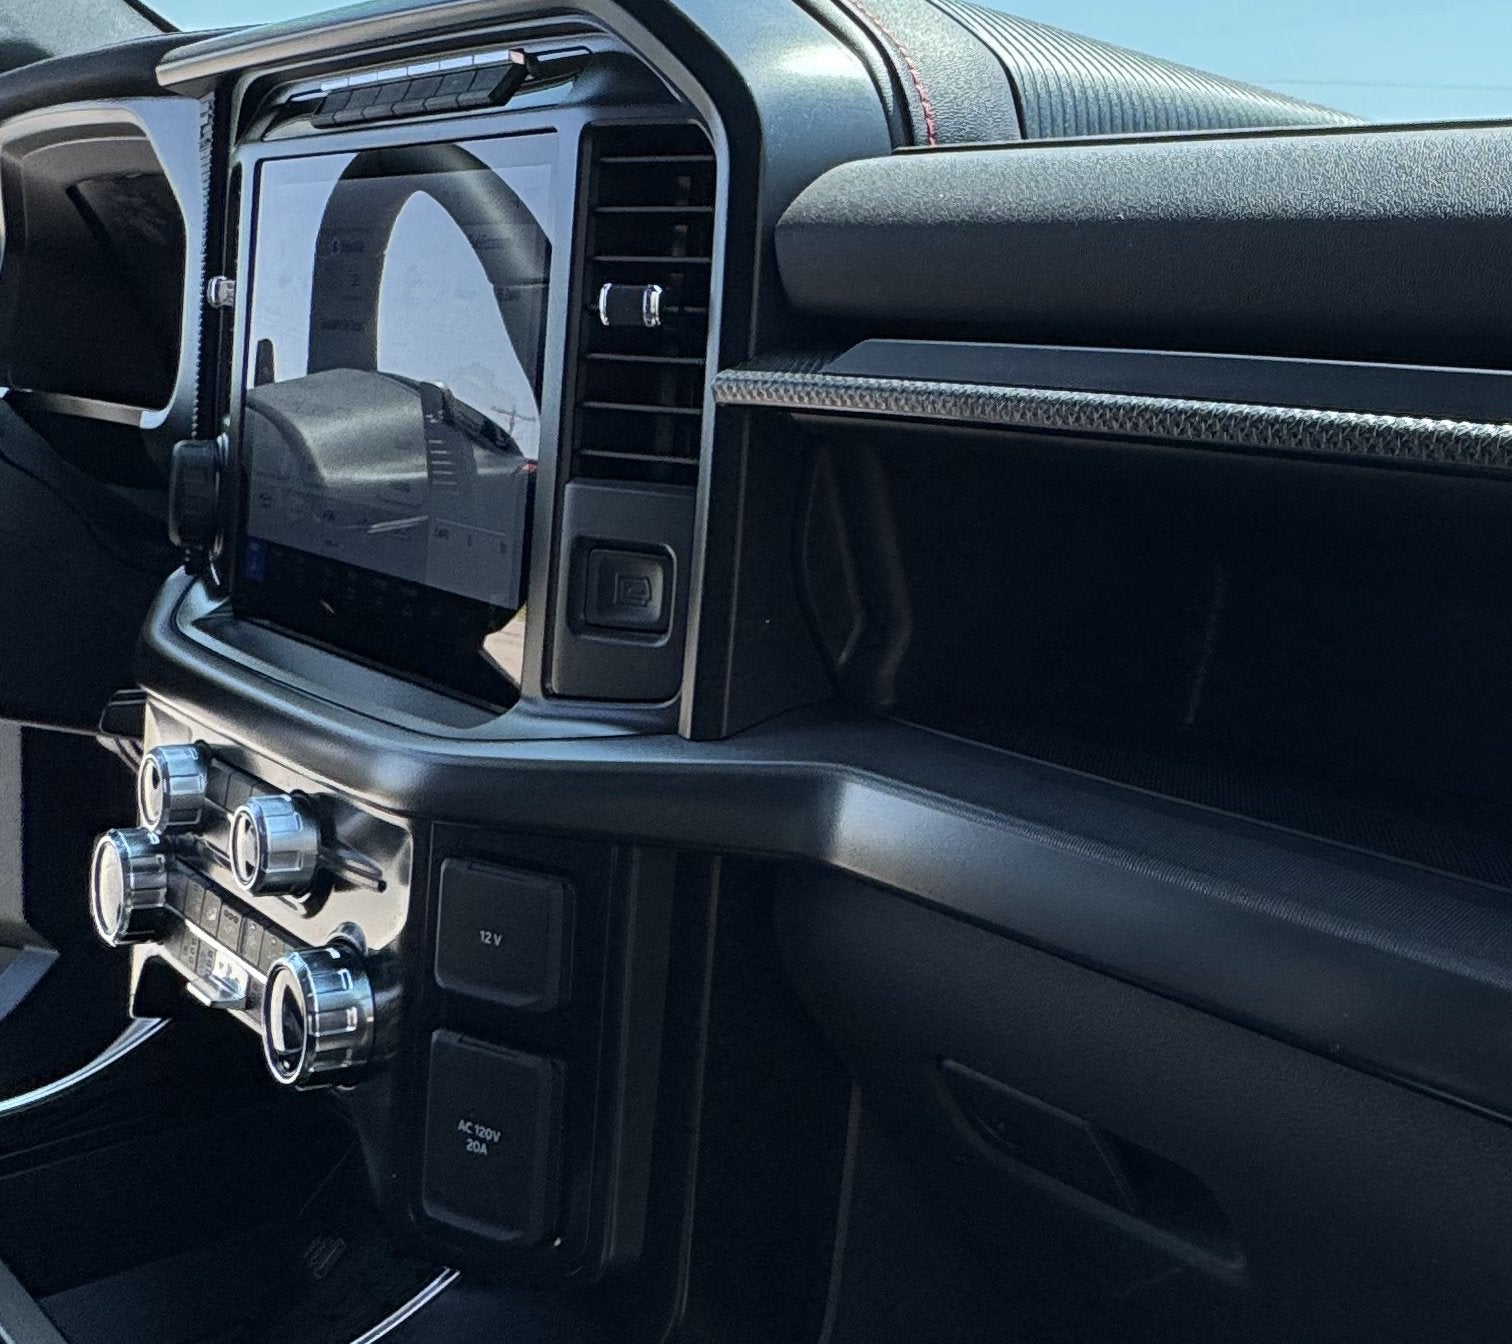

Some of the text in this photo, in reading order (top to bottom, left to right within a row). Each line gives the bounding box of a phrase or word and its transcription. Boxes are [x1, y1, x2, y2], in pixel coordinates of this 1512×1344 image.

[457, 1119, 501, 1142] AC 120V
[466, 1138, 488, 1156] 20A
